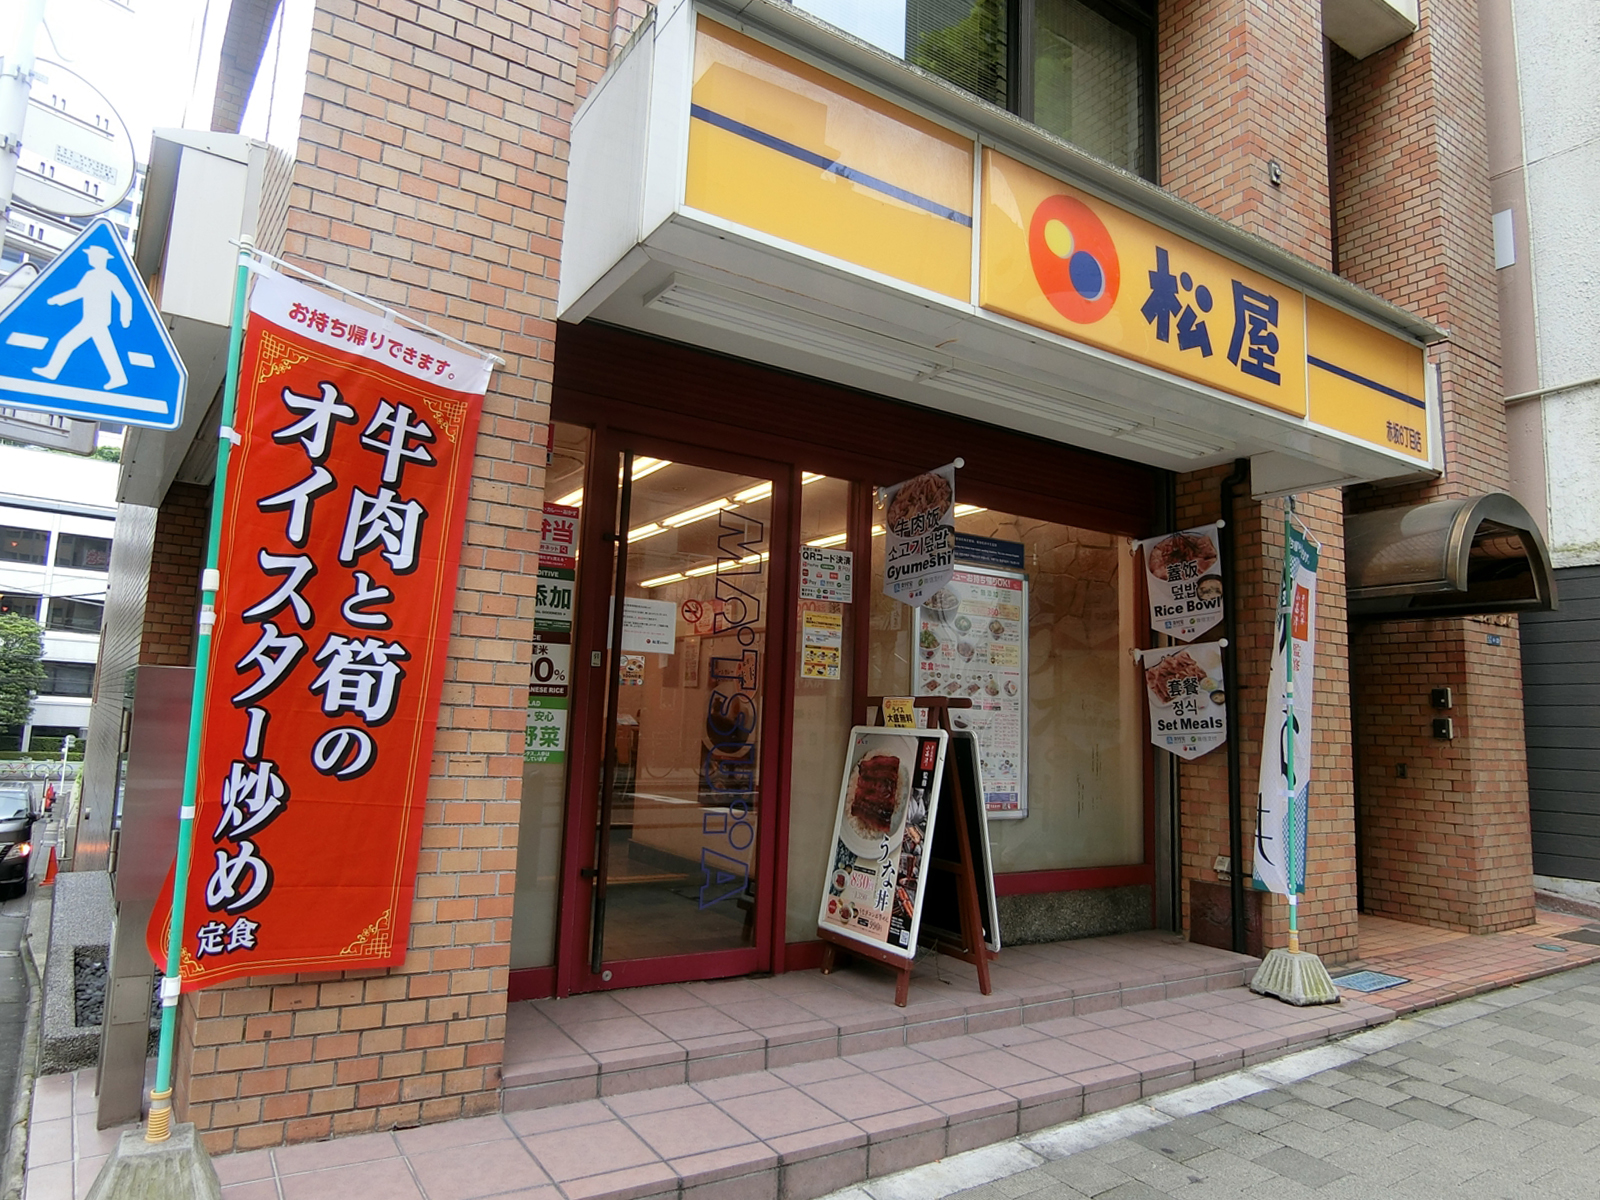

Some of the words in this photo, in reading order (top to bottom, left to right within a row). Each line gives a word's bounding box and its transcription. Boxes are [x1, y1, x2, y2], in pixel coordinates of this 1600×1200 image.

[1140, 245, 1281, 386] 松屋
[288, 302, 456, 381] お持ち帰りできます。
[895, 507, 940, 538] 牛肉饭
[802, 551, 851, 566] QRコード決済
[888, 530, 949, 562] 소고기덮밥
[887, 551, 952, 580] Gyumeshi
[311, 400, 434, 778] 牛肉と筍の
[1171, 582, 1197, 601] 덮밥
[1154, 605, 1184, 617] Rice
[1186, 596, 1221, 613] Bowl
[203, 382, 357, 911] オイスター炒め
[1168, 677, 1199, 697] 套餐
[887, 713, 913, 724] 大盛無料
[1173, 699, 1198, 716] 정식
[1157, 719, 1178, 731] Set
[1180, 716, 1223, 730] Meals
[874, 835, 896, 912] うな丼
[196, 917, 258, 957] 定食
